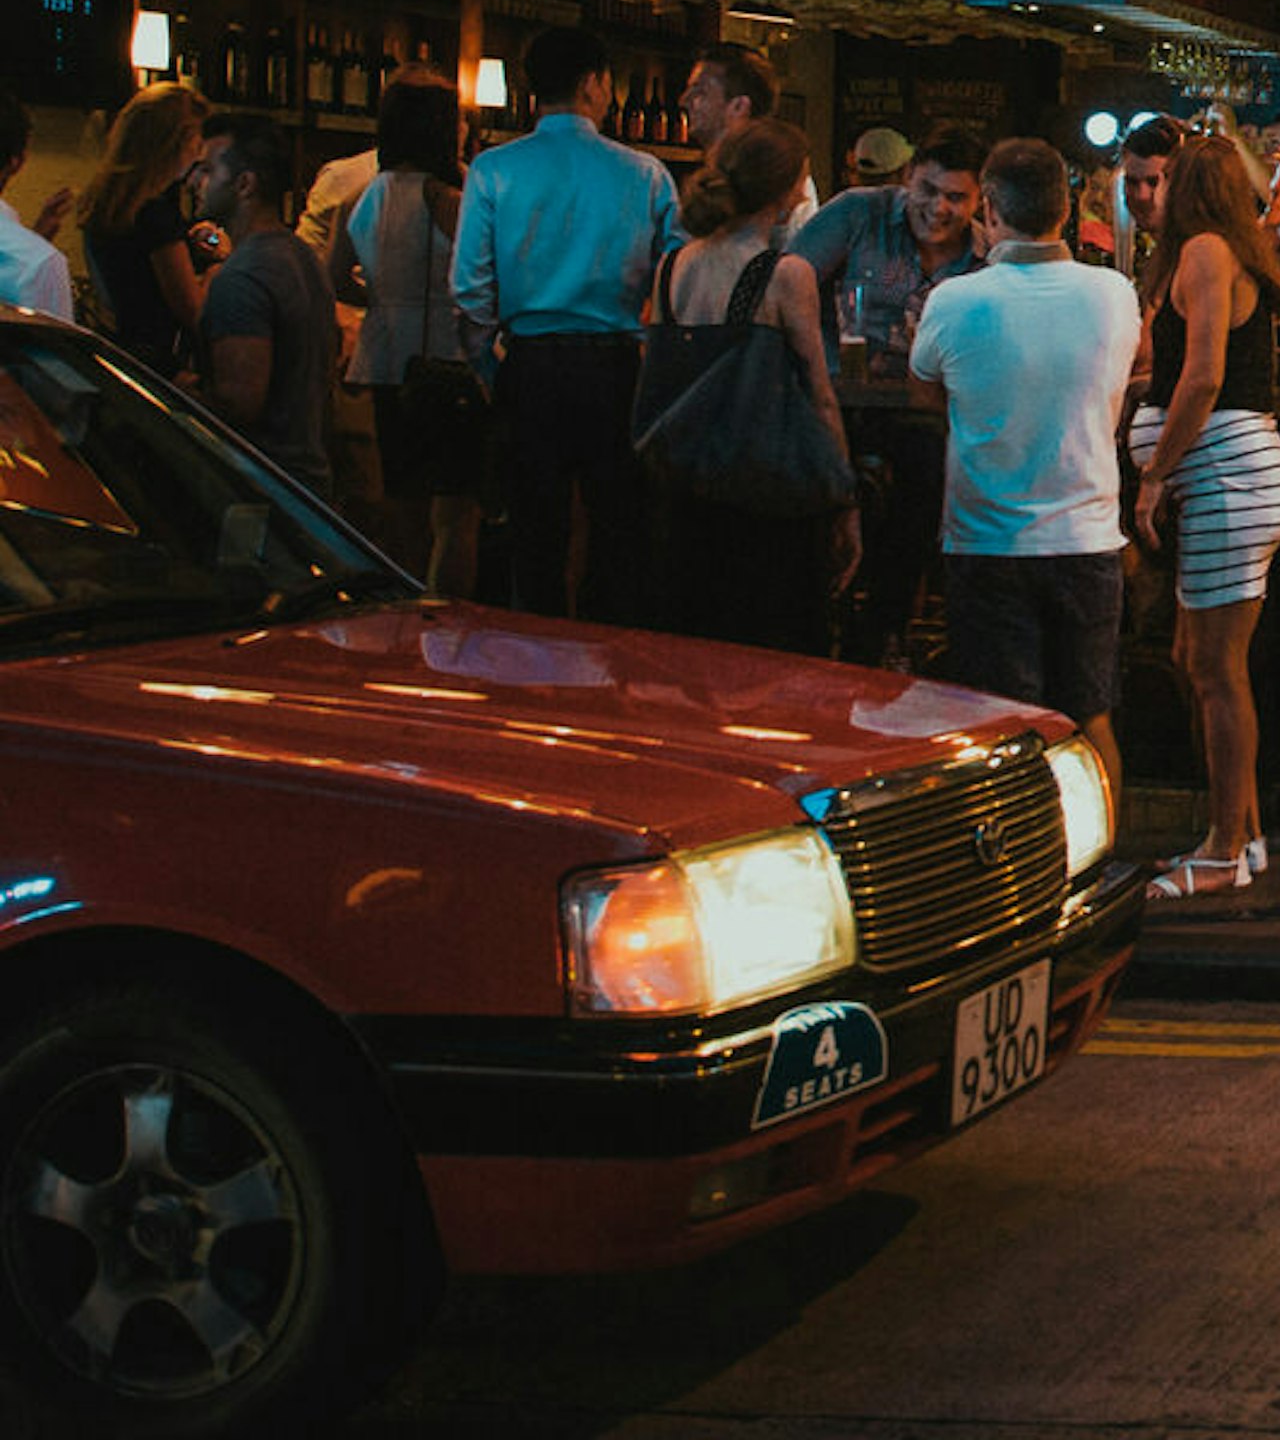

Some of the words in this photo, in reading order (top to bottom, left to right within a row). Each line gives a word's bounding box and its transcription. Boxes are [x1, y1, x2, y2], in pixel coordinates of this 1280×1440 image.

[984, 977, 1023, 1041] UD
[813, 1024, 840, 1068] 4
[961, 1025, 1039, 1115] 9300
[785, 1062, 863, 1109] SEATS
